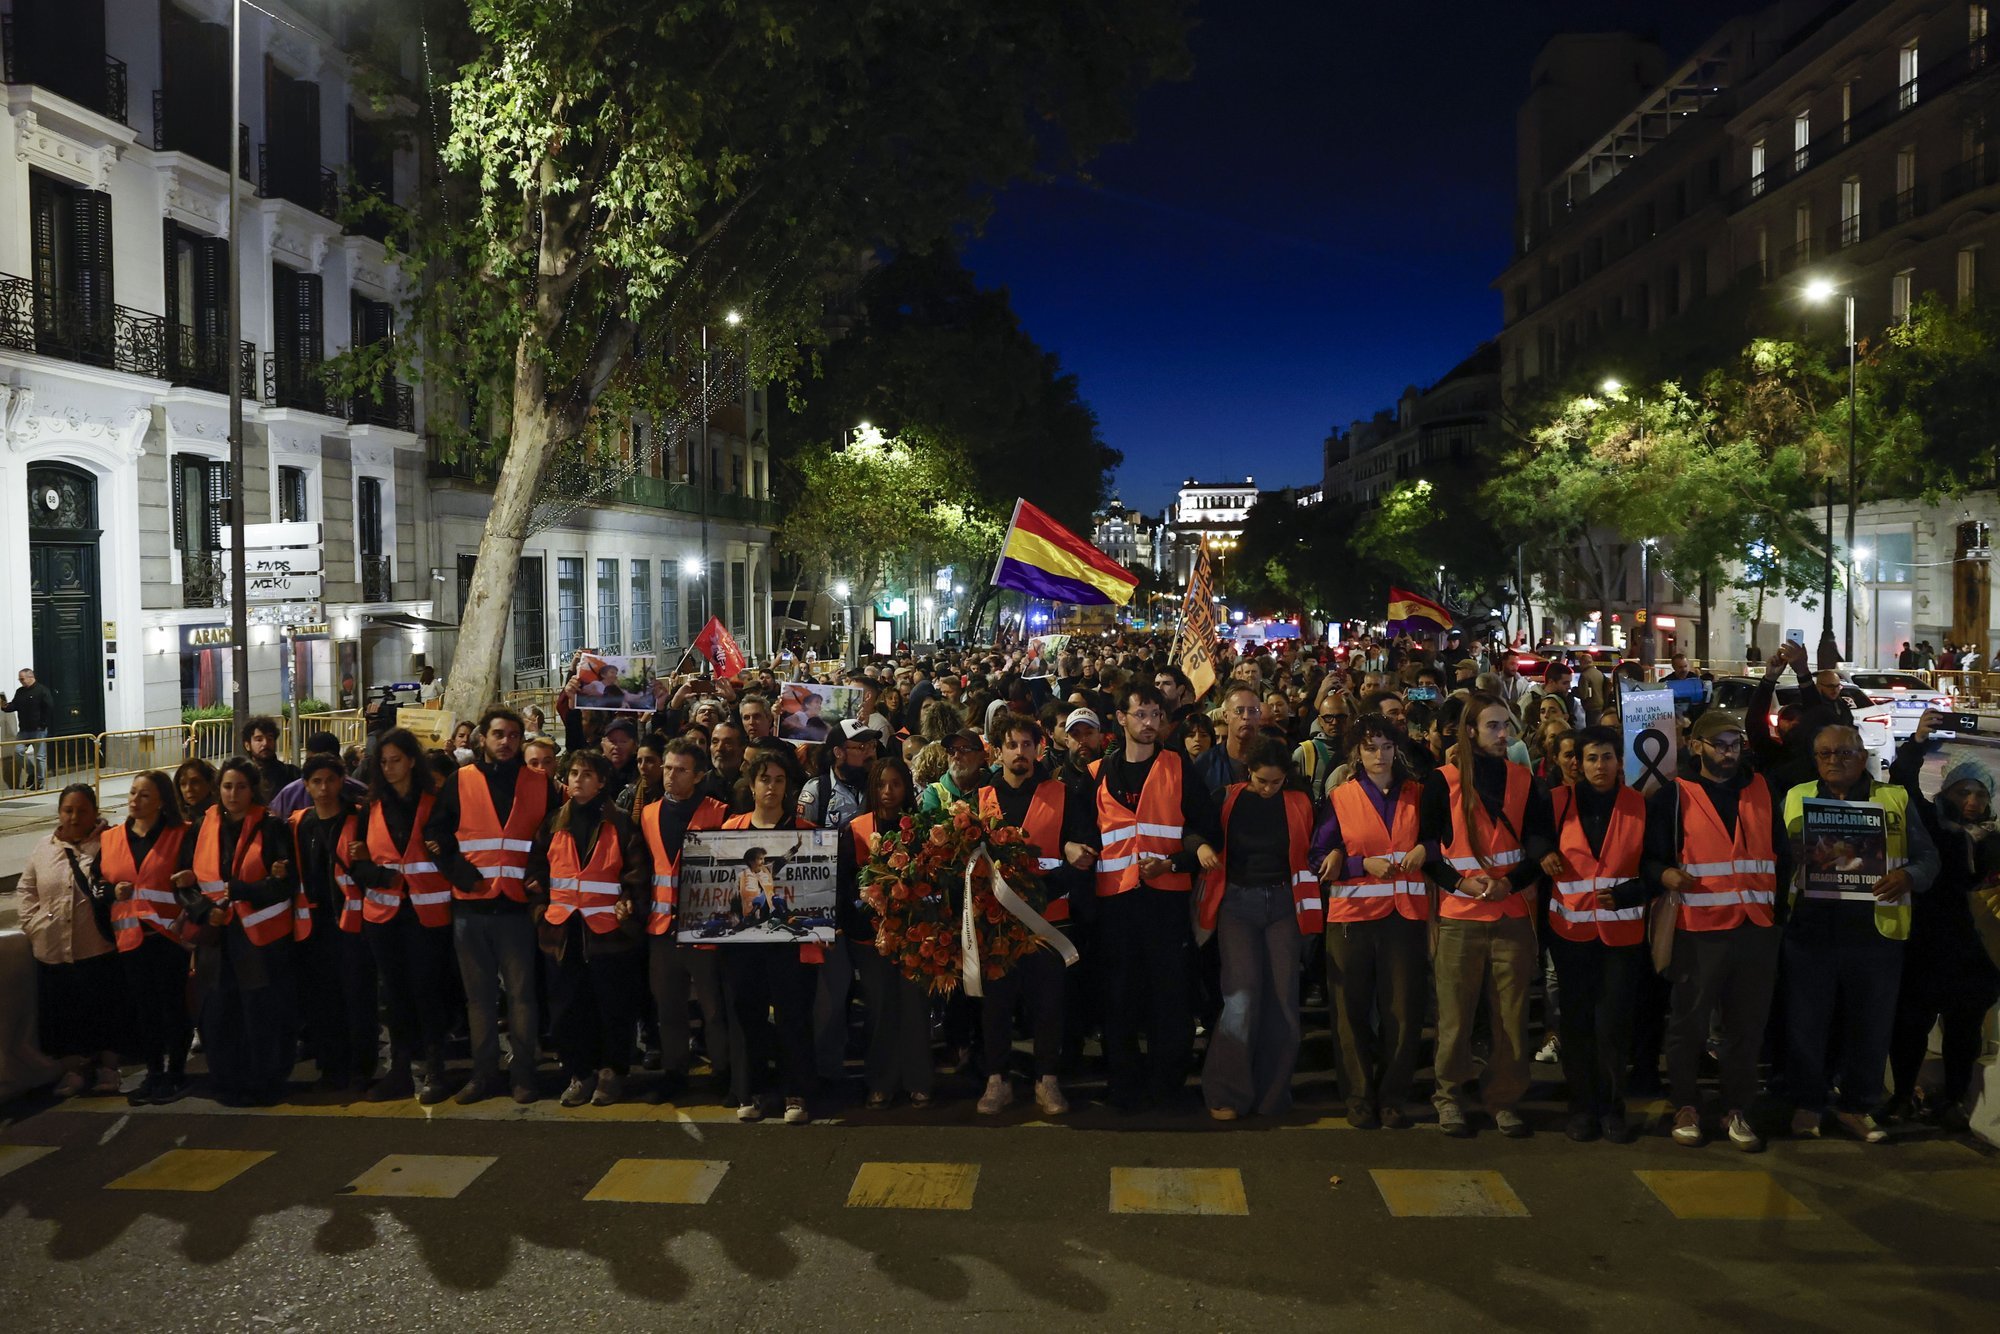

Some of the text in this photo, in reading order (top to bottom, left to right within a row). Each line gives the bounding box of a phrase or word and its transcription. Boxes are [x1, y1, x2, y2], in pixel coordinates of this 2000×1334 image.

[48, 495, 56, 504] 58
[1626, 712, 1673, 723] MARICARMEN
[1807, 812, 1881, 827] MARICARMEN
[681, 866, 830, 884] UNA VIDA BARRIO
[1809, 873, 1843, 883] GRACIAS
[1844, 874, 1860, 884] POR
